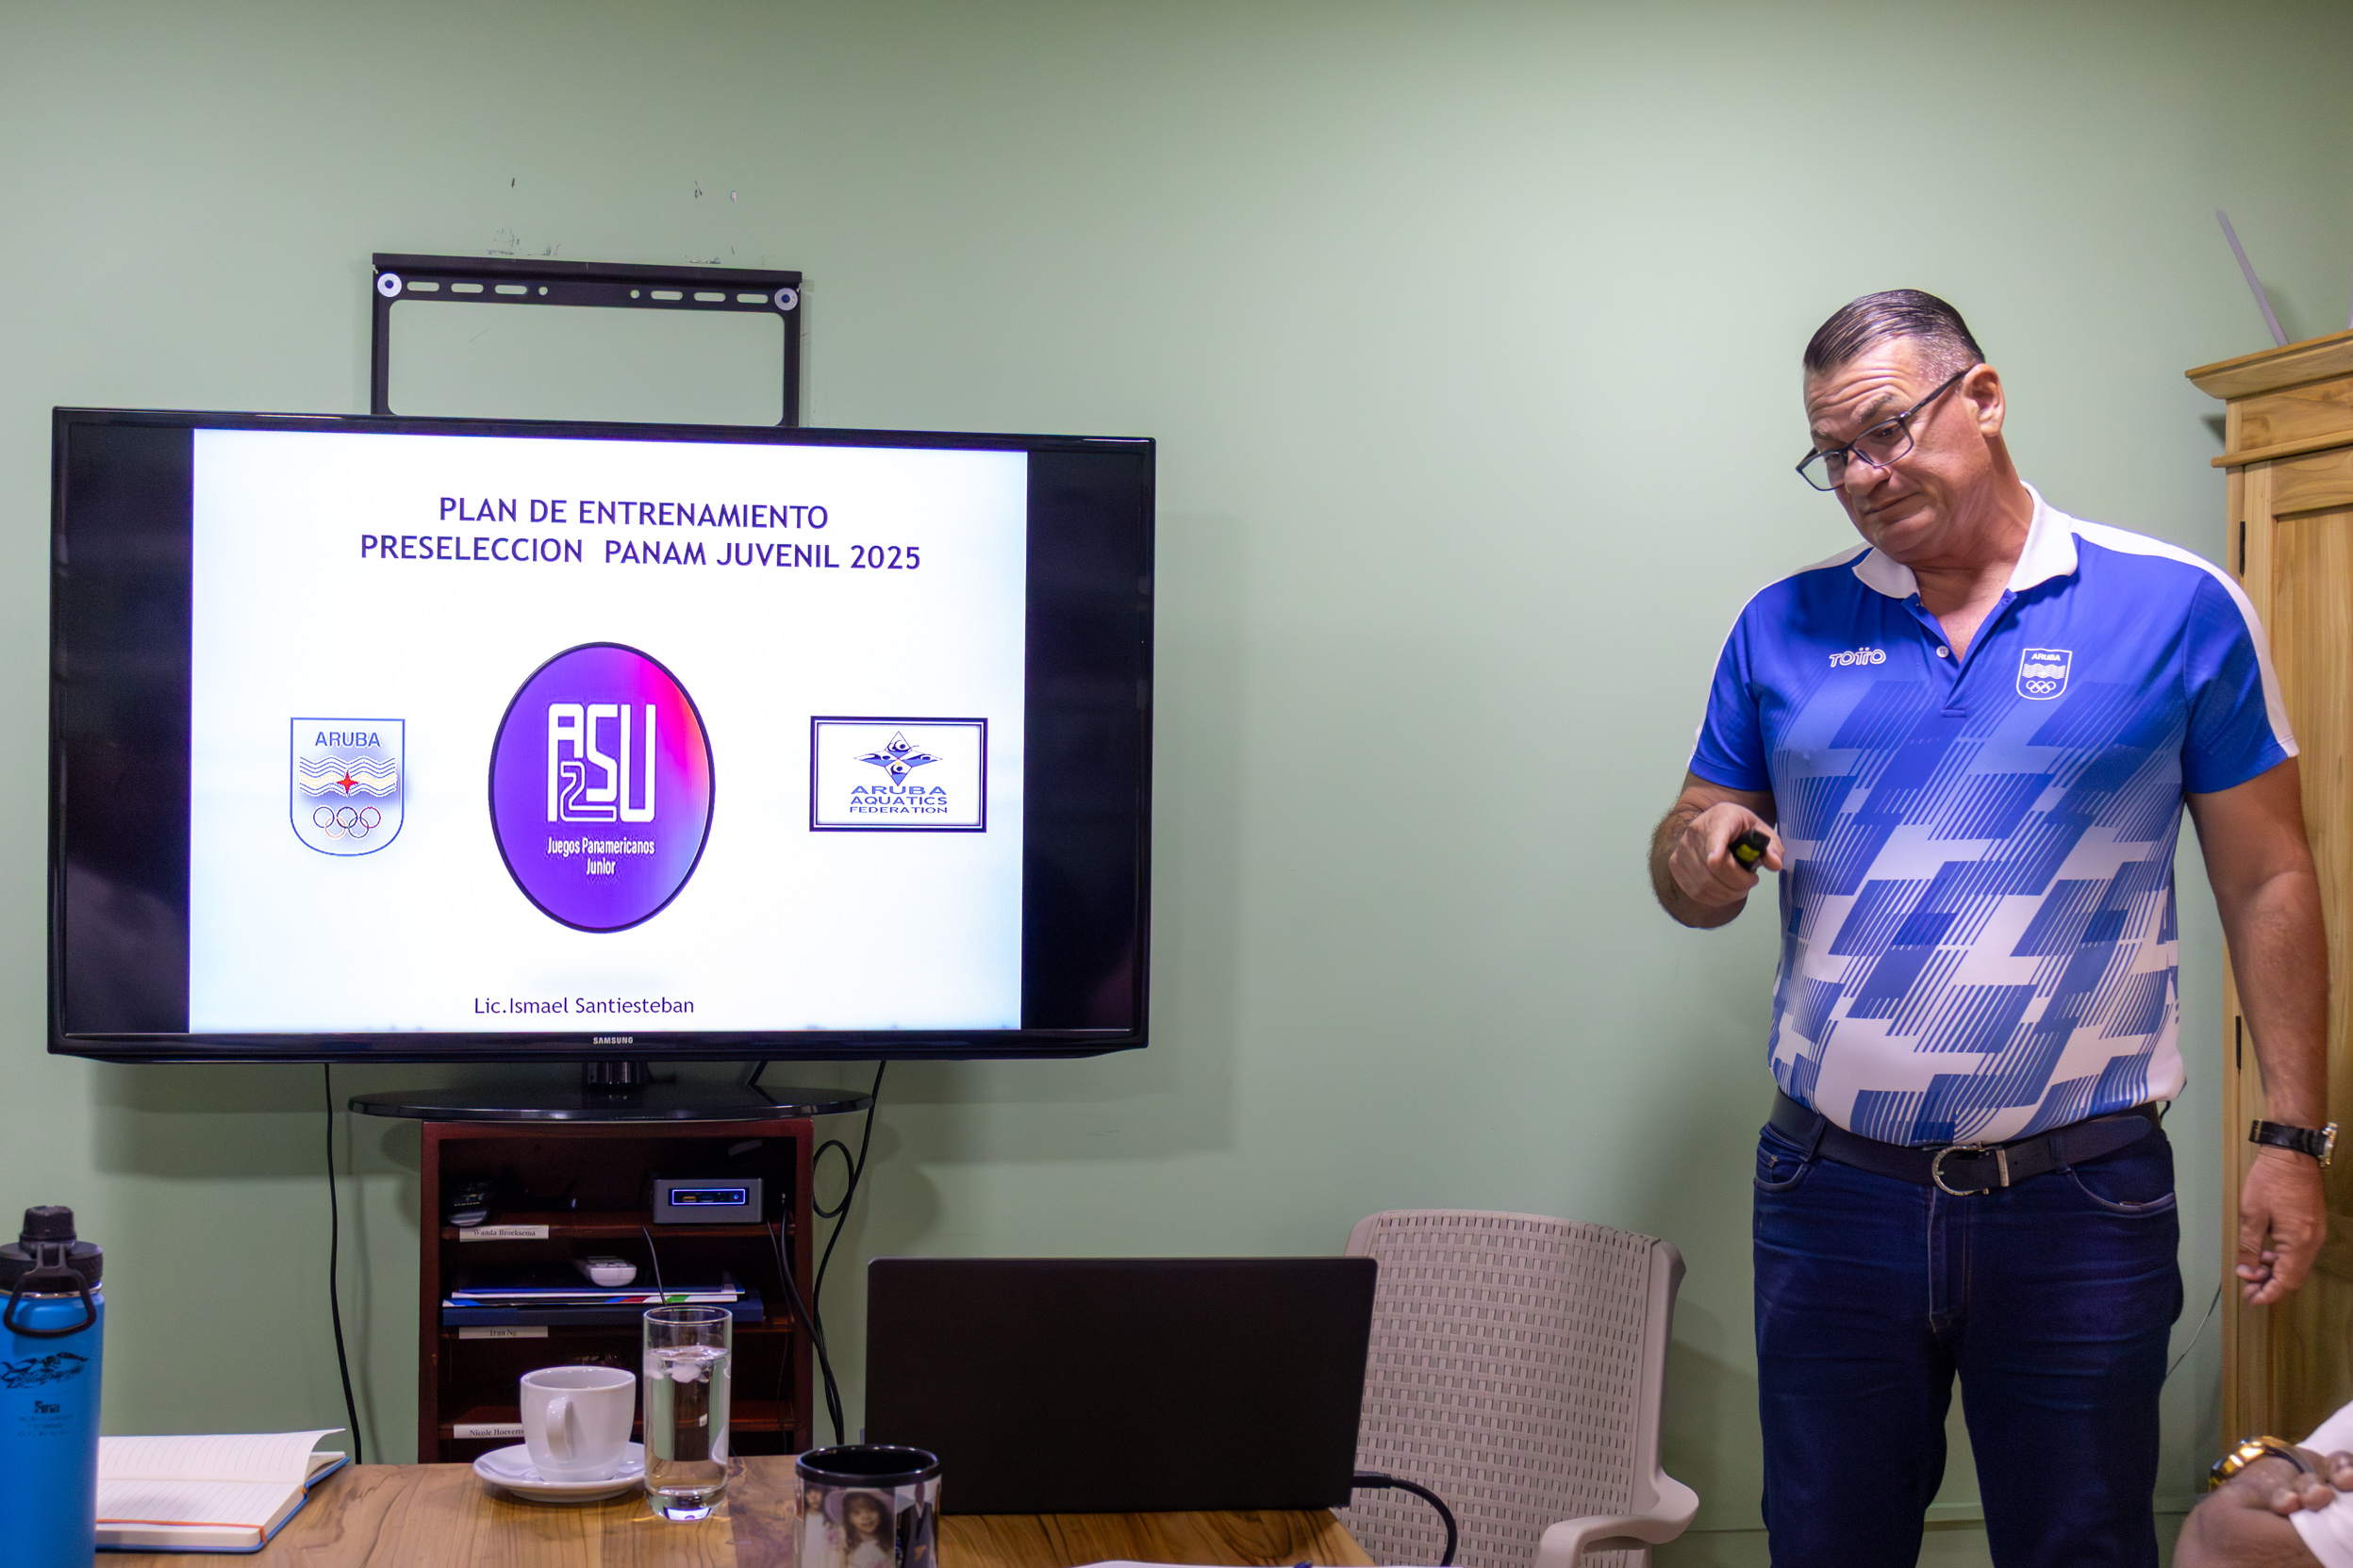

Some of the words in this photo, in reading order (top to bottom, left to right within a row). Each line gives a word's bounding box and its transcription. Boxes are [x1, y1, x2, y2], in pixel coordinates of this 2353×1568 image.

[440, 497, 516, 521] PLAN
[531, 500, 567, 522] DE
[580, 501, 828, 529] ENTRENAMIENTO
[362, 535, 582, 562] PRESELECCION
[605, 540, 706, 565] PANAM
[717, 543, 839, 568] JUVENIL
[851, 545, 920, 569] 2025
[315, 732, 381, 747] ARUBA
[851, 785, 947, 796] ARUBA
[851, 796, 948, 806] AQUATICS
[547, 836, 580, 857] Juegos
[582, 836, 655, 854] Panamericanos
[587, 857, 616, 875] Junior
[576, 997, 693, 1013] Santiesteban
[593, 1036, 634, 1045] SAMSUNG
